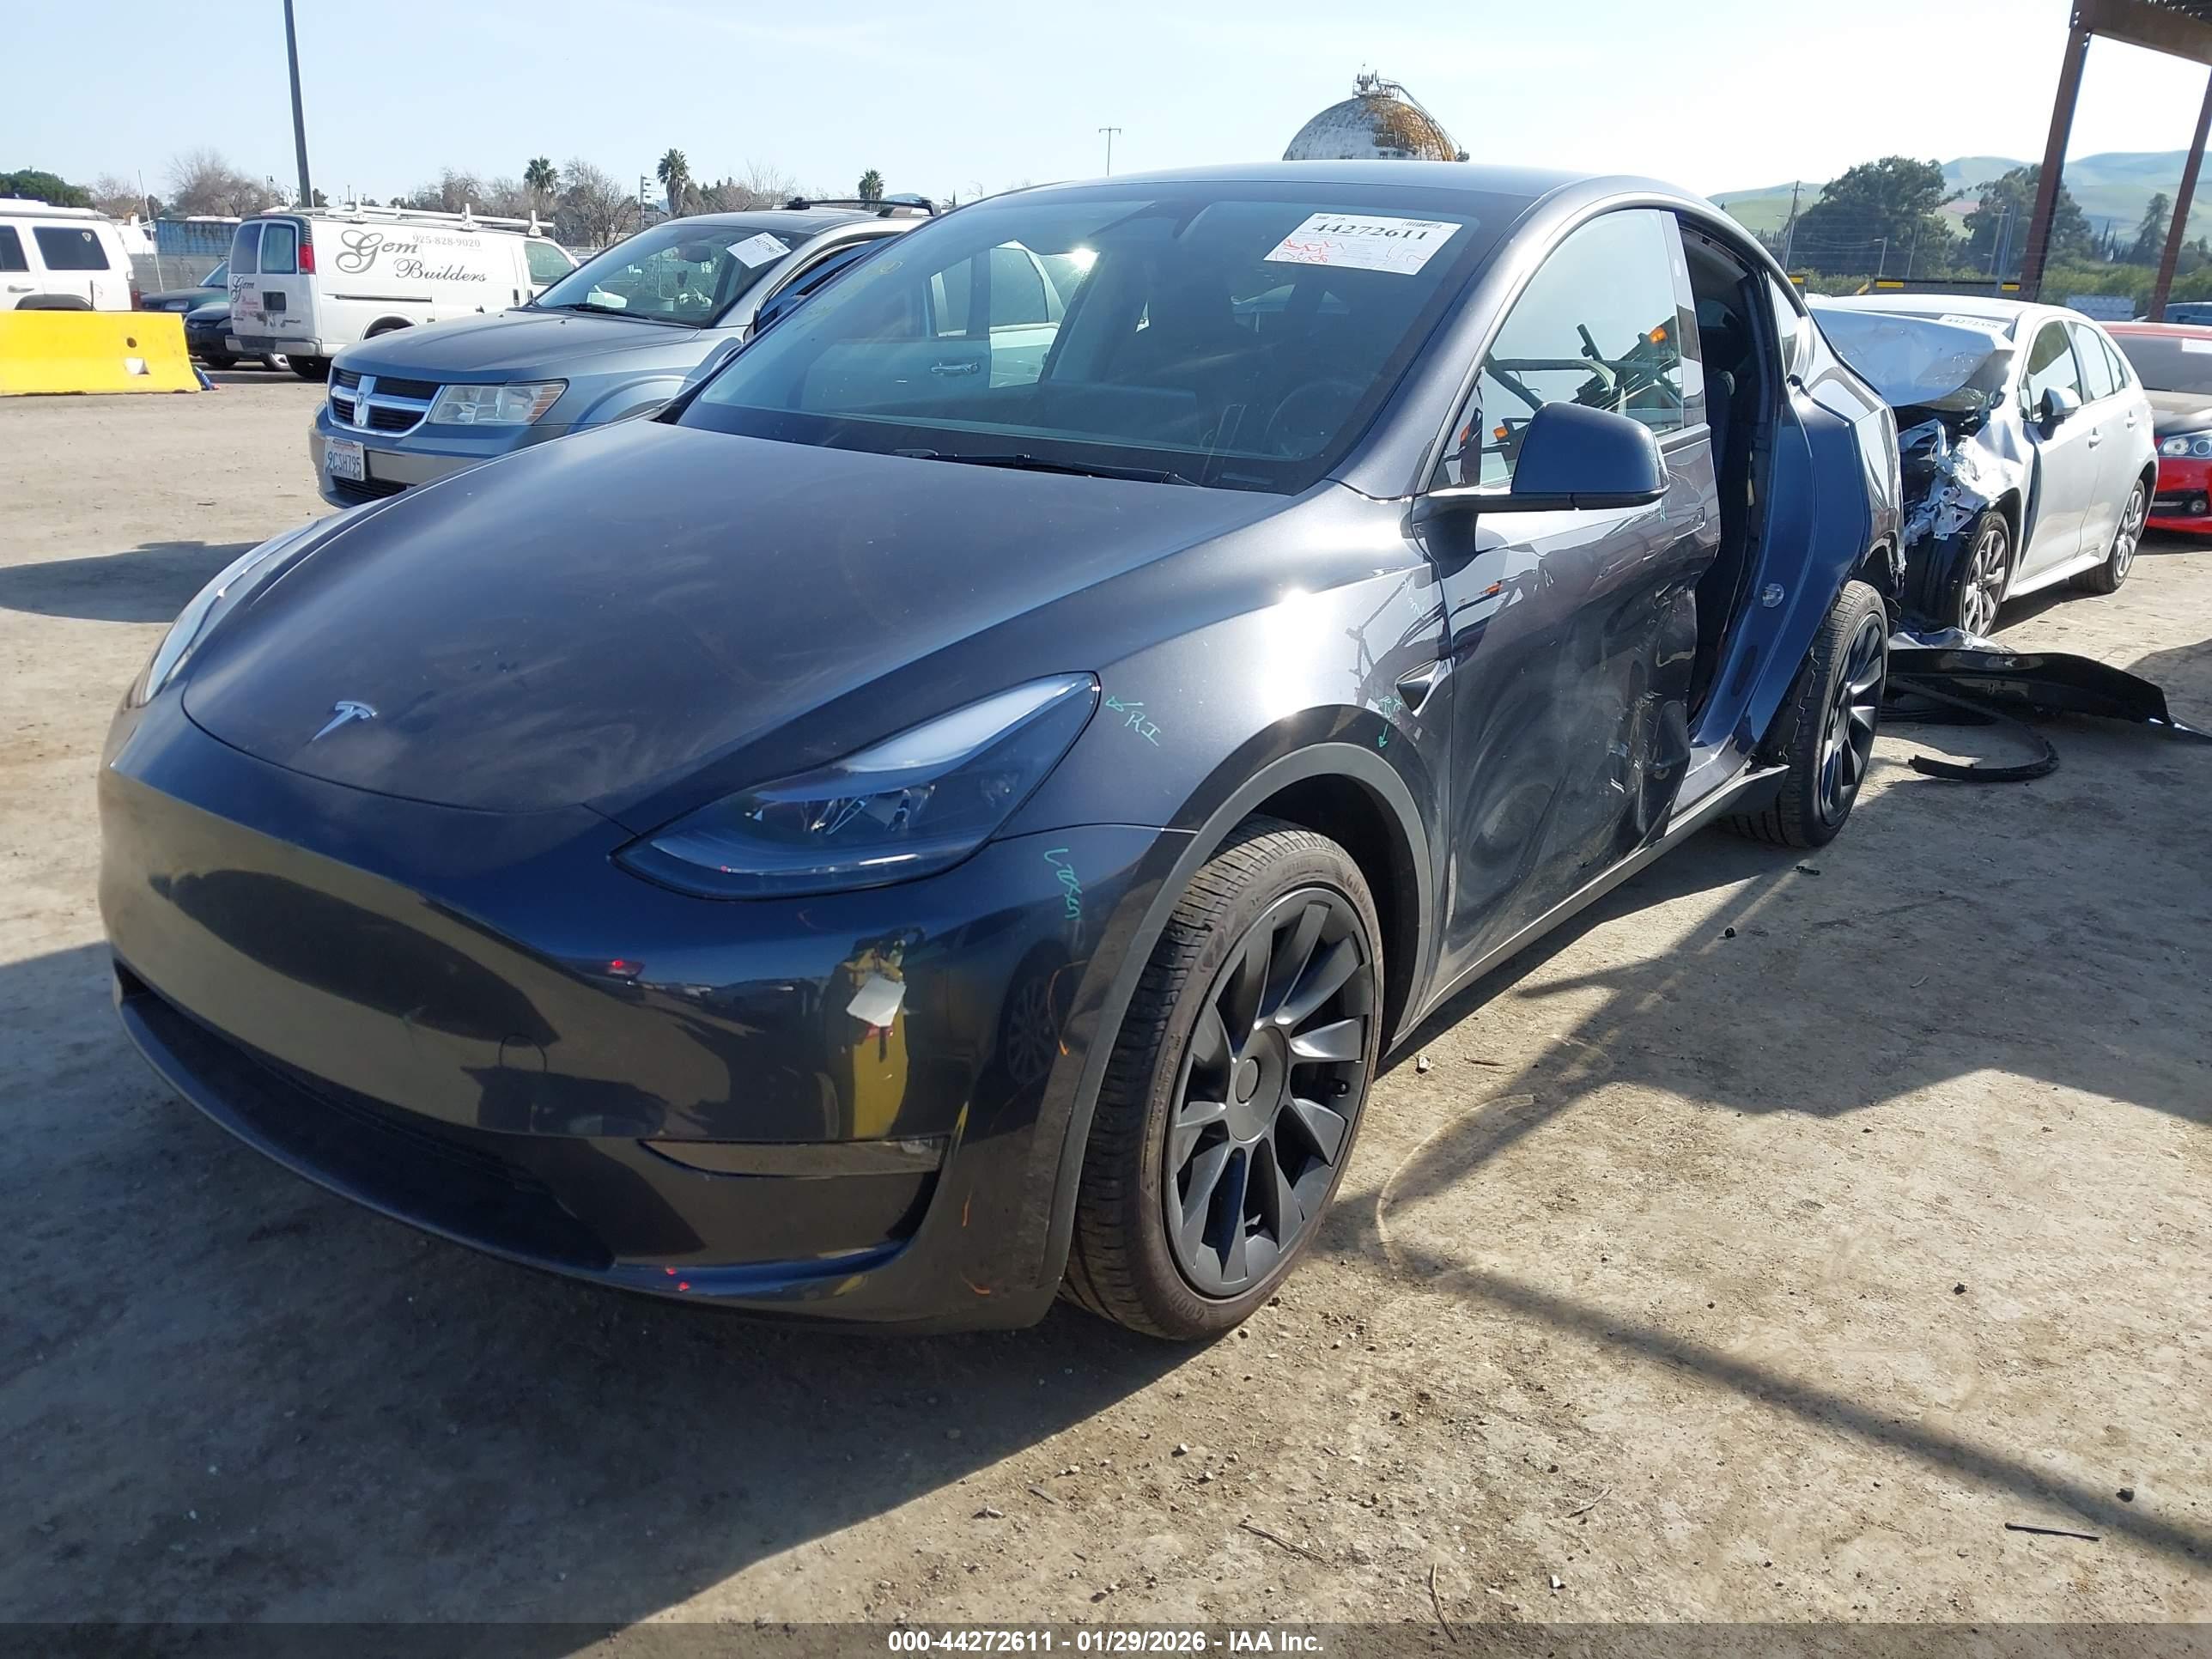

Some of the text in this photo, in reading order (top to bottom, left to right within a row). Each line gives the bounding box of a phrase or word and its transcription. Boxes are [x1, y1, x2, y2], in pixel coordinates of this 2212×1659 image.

[412, 233, 481, 249] 925-828-9020
[1311, 222, 1430, 241] 44272611
[335, 228, 419, 275] Gem
[392, 258, 488, 283] Builders
[230, 275, 255, 303] Gem
[327, 450, 362, 475] 9CSH795
